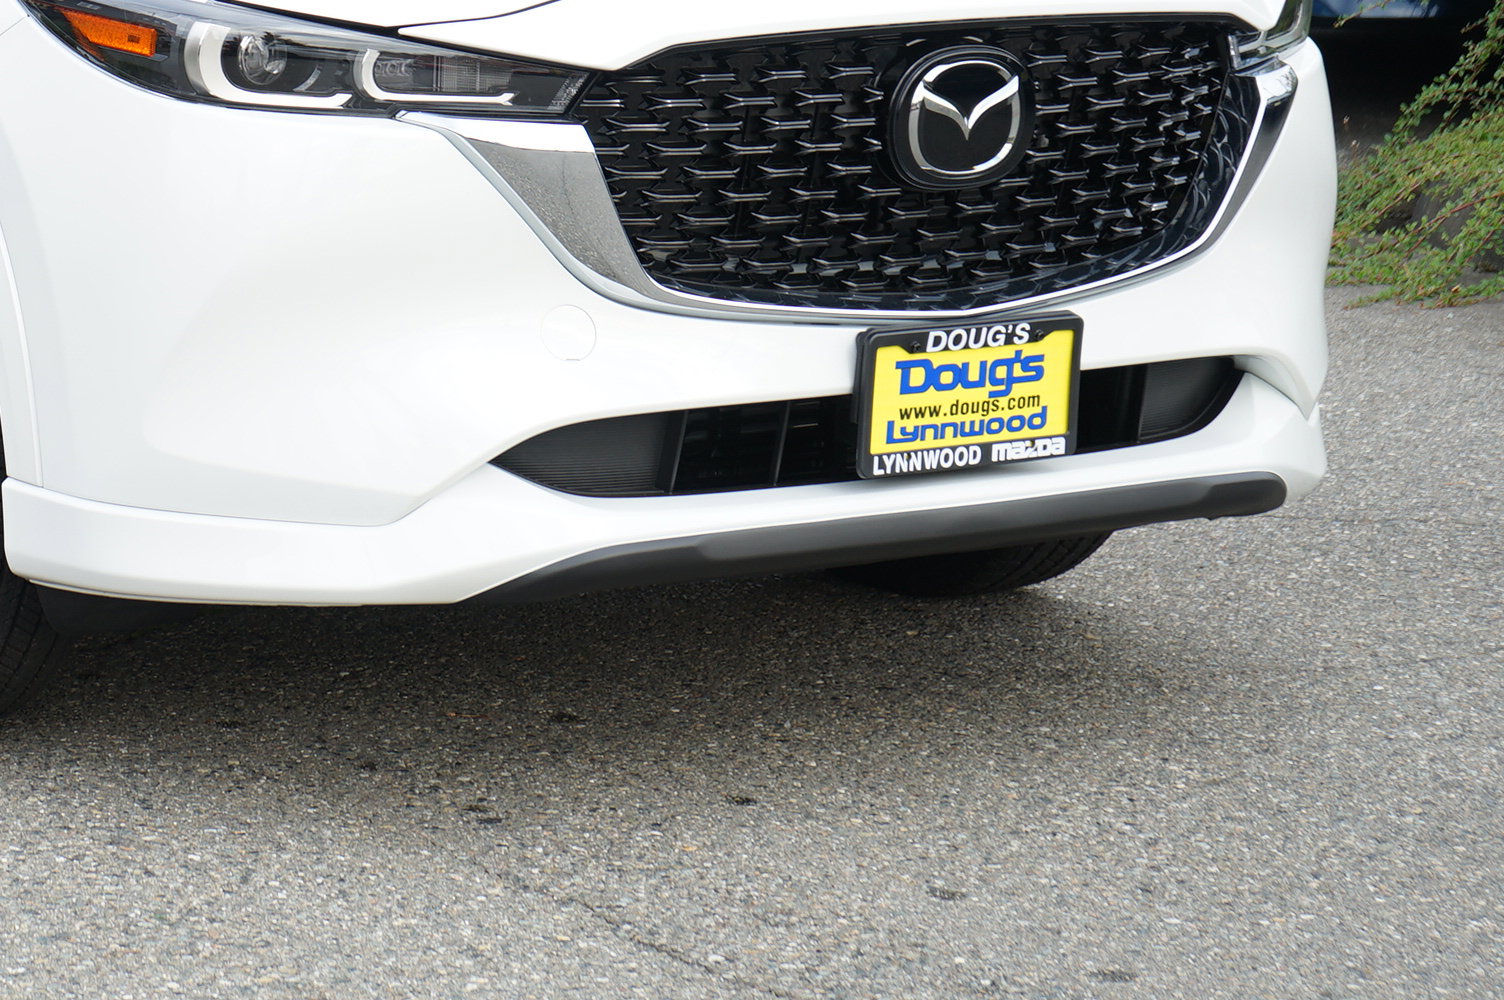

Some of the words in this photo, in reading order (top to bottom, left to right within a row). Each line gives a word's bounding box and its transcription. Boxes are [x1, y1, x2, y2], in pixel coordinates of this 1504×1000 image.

[926, 323, 1030, 352] DOUG'S
[895, 350, 1045, 398] Doug's
[899, 395, 1040, 420] www.dougs.com
[886, 406, 1048, 444] Lynnwood
[873, 445, 982, 476] LYNNWOOD
